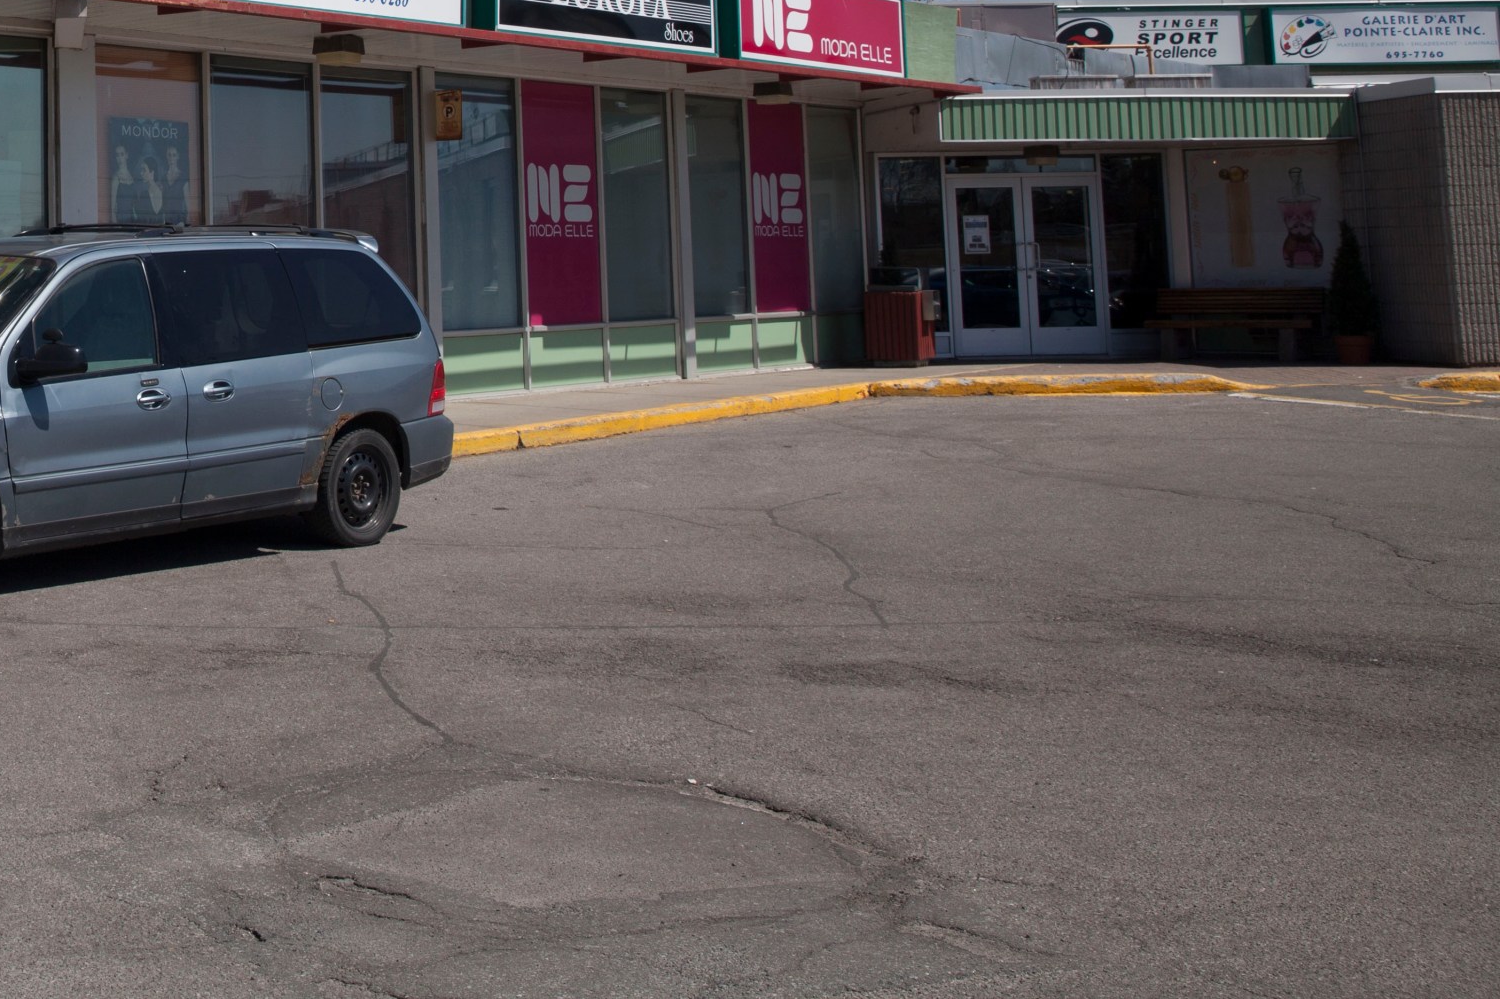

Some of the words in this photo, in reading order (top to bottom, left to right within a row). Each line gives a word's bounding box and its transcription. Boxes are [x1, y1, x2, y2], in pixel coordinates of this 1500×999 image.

[1139, 18, 1219, 29] STINGER
[1362, 15, 1419, 26] GALERIE
[1425, 14, 1466, 25] D'ART
[664, 22, 694, 44] Shoes
[1137, 31, 1218, 45] SPORT
[1344, 26, 1451, 37] POINTE-CLAIRE
[1456, 26, 1486, 36] INC.
[820, 36, 857, 61] MODA
[860, 42, 892, 65] ELLE
[1386, 50, 1444, 59] 695-7760
[121, 124, 179, 139] MONDOR
[529, 224, 562, 237] MODA
[564, 224, 594, 238] ELLE
[755, 225, 780, 237] MODA
[781, 225, 805, 237] ELLE
